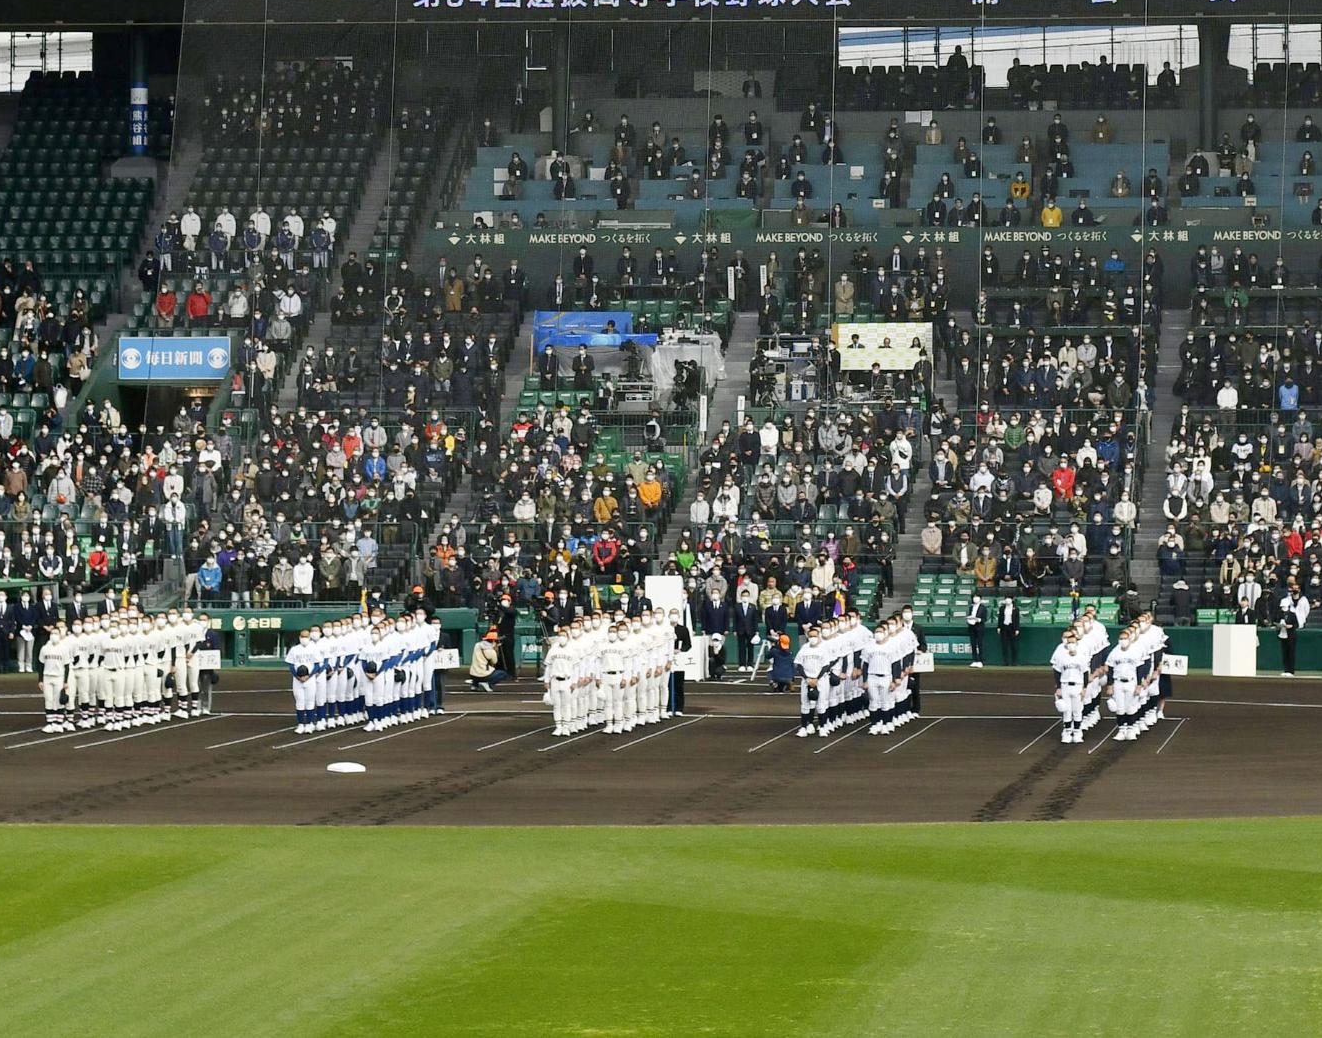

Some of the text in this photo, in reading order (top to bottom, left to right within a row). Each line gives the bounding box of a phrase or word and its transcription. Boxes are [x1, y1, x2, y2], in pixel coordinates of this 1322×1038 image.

[465, 233, 505, 245] 大林組
[529, 233, 651, 244] MAKE BEYOND つくるを拓く
[692, 232, 732, 244] 大林組
[755, 233, 783, 243] MAKE
[784, 233, 823, 243] BEYOND
[919, 231, 960, 243] 大林組
[984, 231, 1107, 242] MAKE BEYOND つくるを拓く
[1148, 230, 1189, 242] 大林組
[1213, 230, 1241, 241] MAKE
[1242, 230, 1282, 241] BEYOND
[146, 350, 203, 367] 毎日新聞
